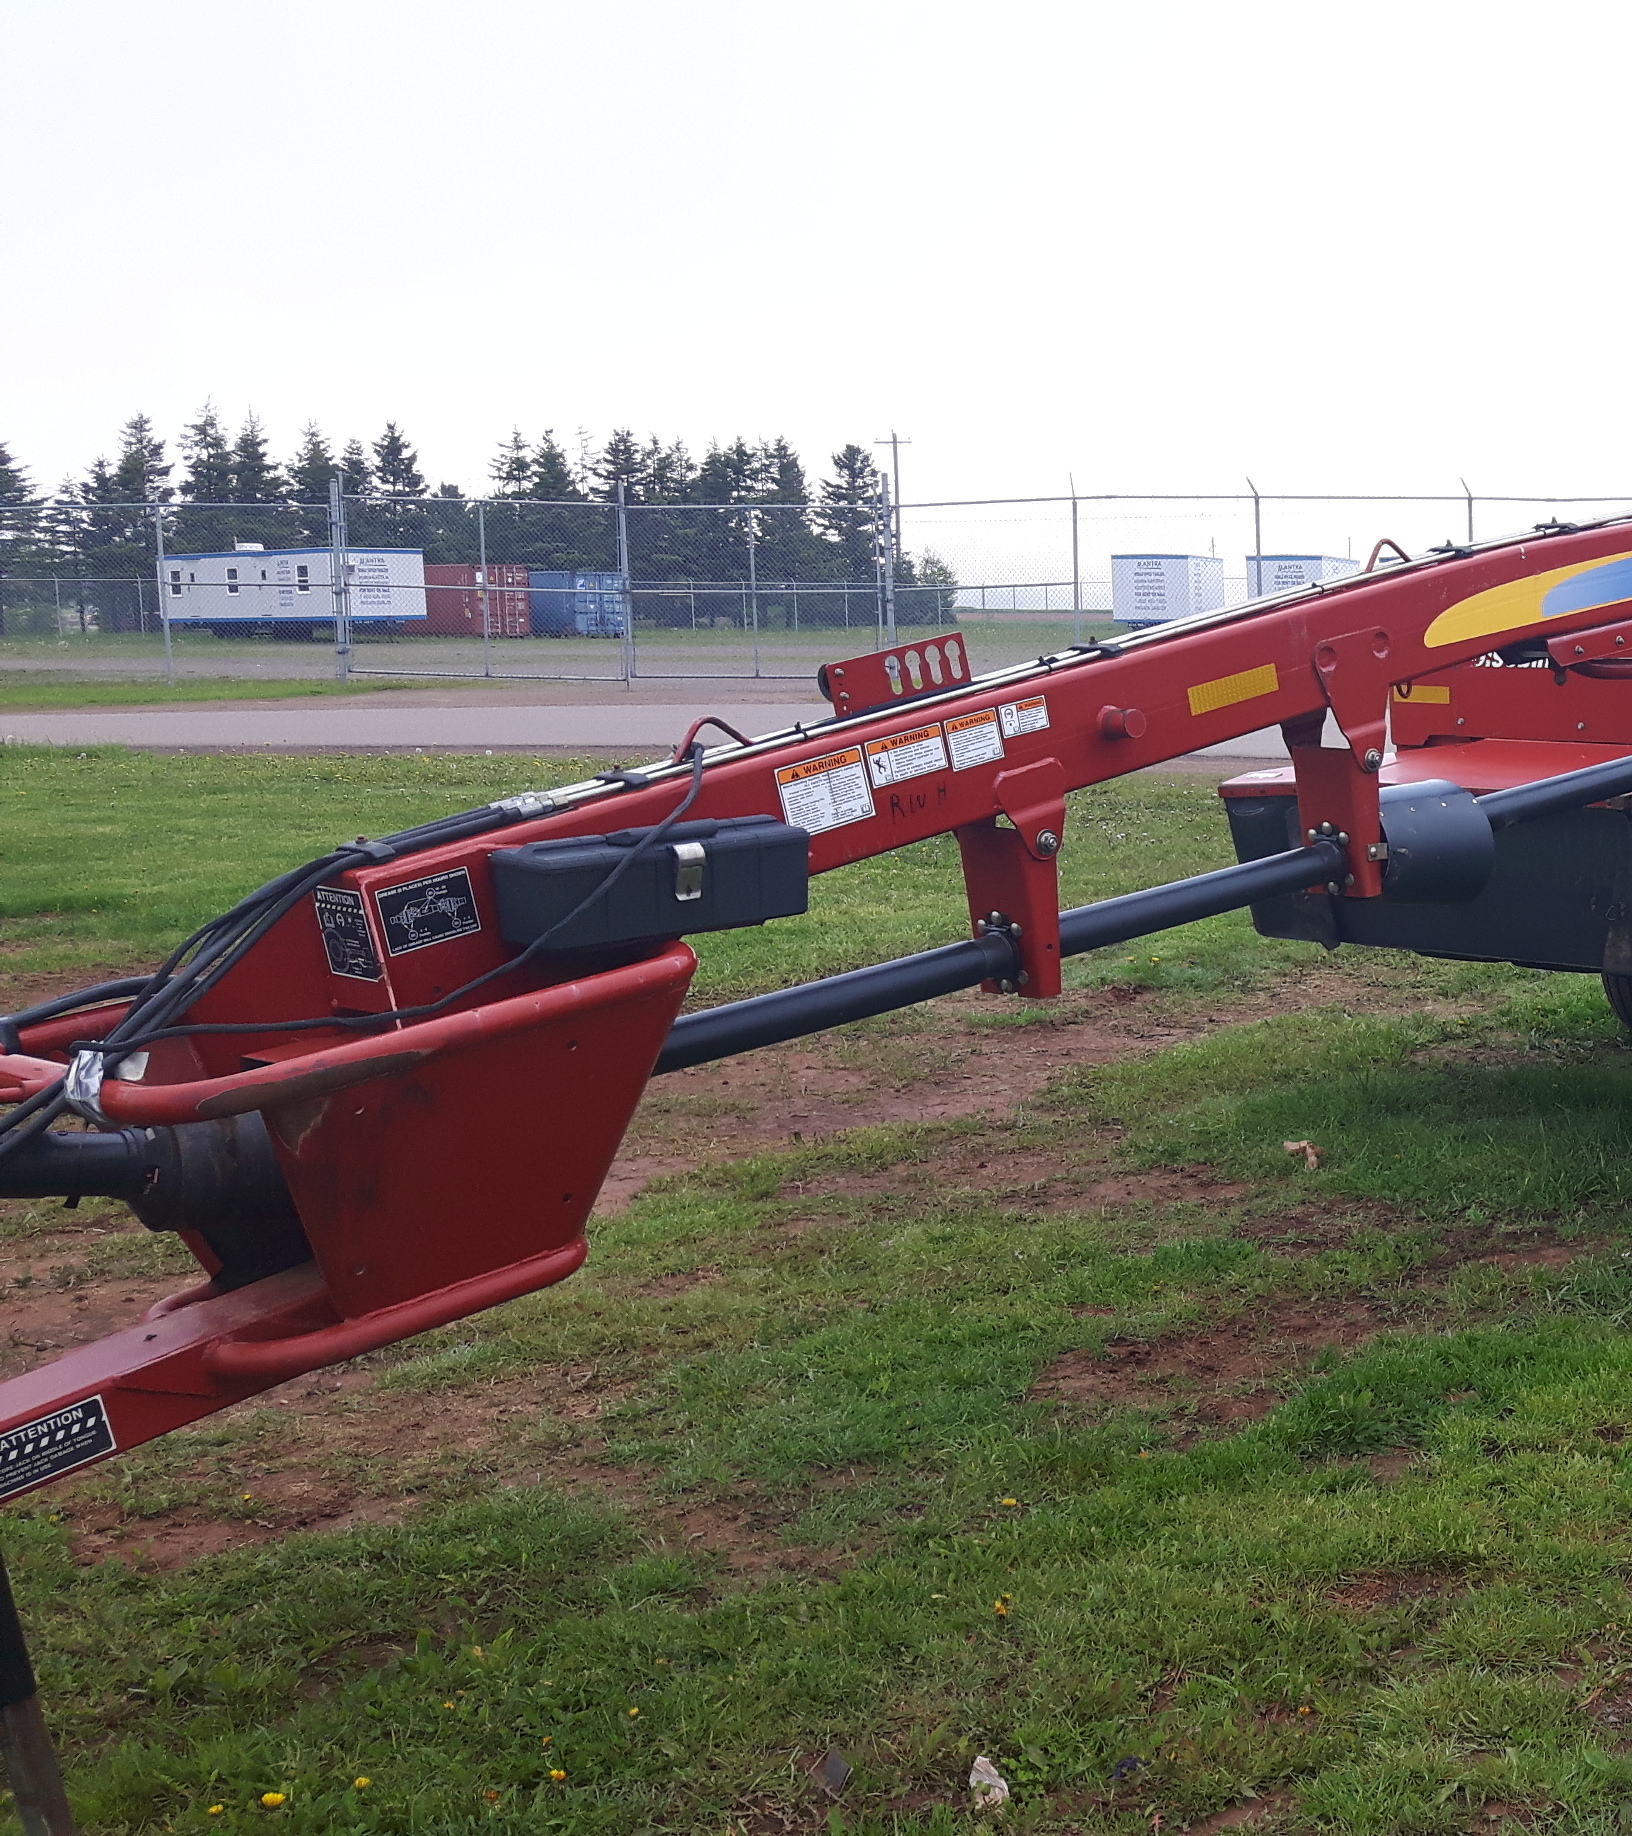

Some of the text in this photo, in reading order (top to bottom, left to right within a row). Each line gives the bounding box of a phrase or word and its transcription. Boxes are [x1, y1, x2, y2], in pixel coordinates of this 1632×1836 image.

[958, 714, 991, 728] WARNING
[890, 729, 930, 747] WARNING
[803, 754, 847, 775] WARNING
[316, 890, 355, 906] ATTENTION
[0, 1408, 84, 1451] ATTENTION
[15, 1458, 31, 1468] JACK
